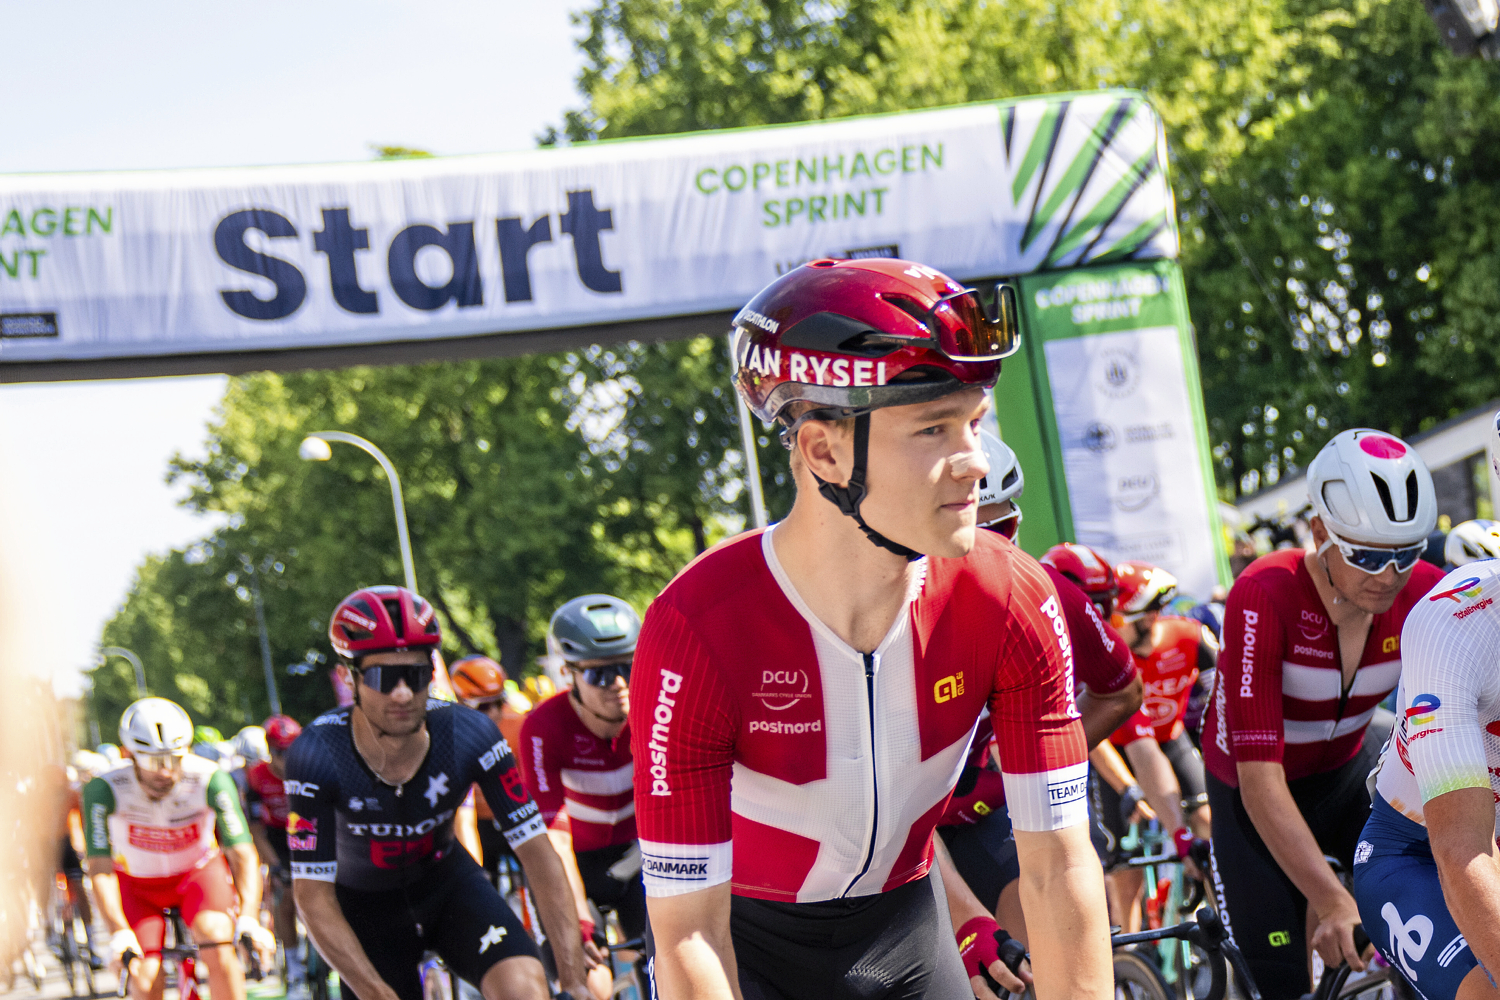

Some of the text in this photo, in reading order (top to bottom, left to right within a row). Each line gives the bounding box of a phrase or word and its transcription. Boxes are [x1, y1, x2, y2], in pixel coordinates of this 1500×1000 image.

[694, 143, 945, 195] COPENHAGEN
[762, 188, 890, 228] SPRINT
[213, 188, 623, 321] Start
[1071, 298, 1143, 325] SPRINT
[1239, 608, 1259, 699] postnord
[762, 670, 798, 685] DCU
[650, 668, 684, 797] postnord
[749, 719, 822, 735] postnord
[1049, 786, 1079, 801] TEAM
